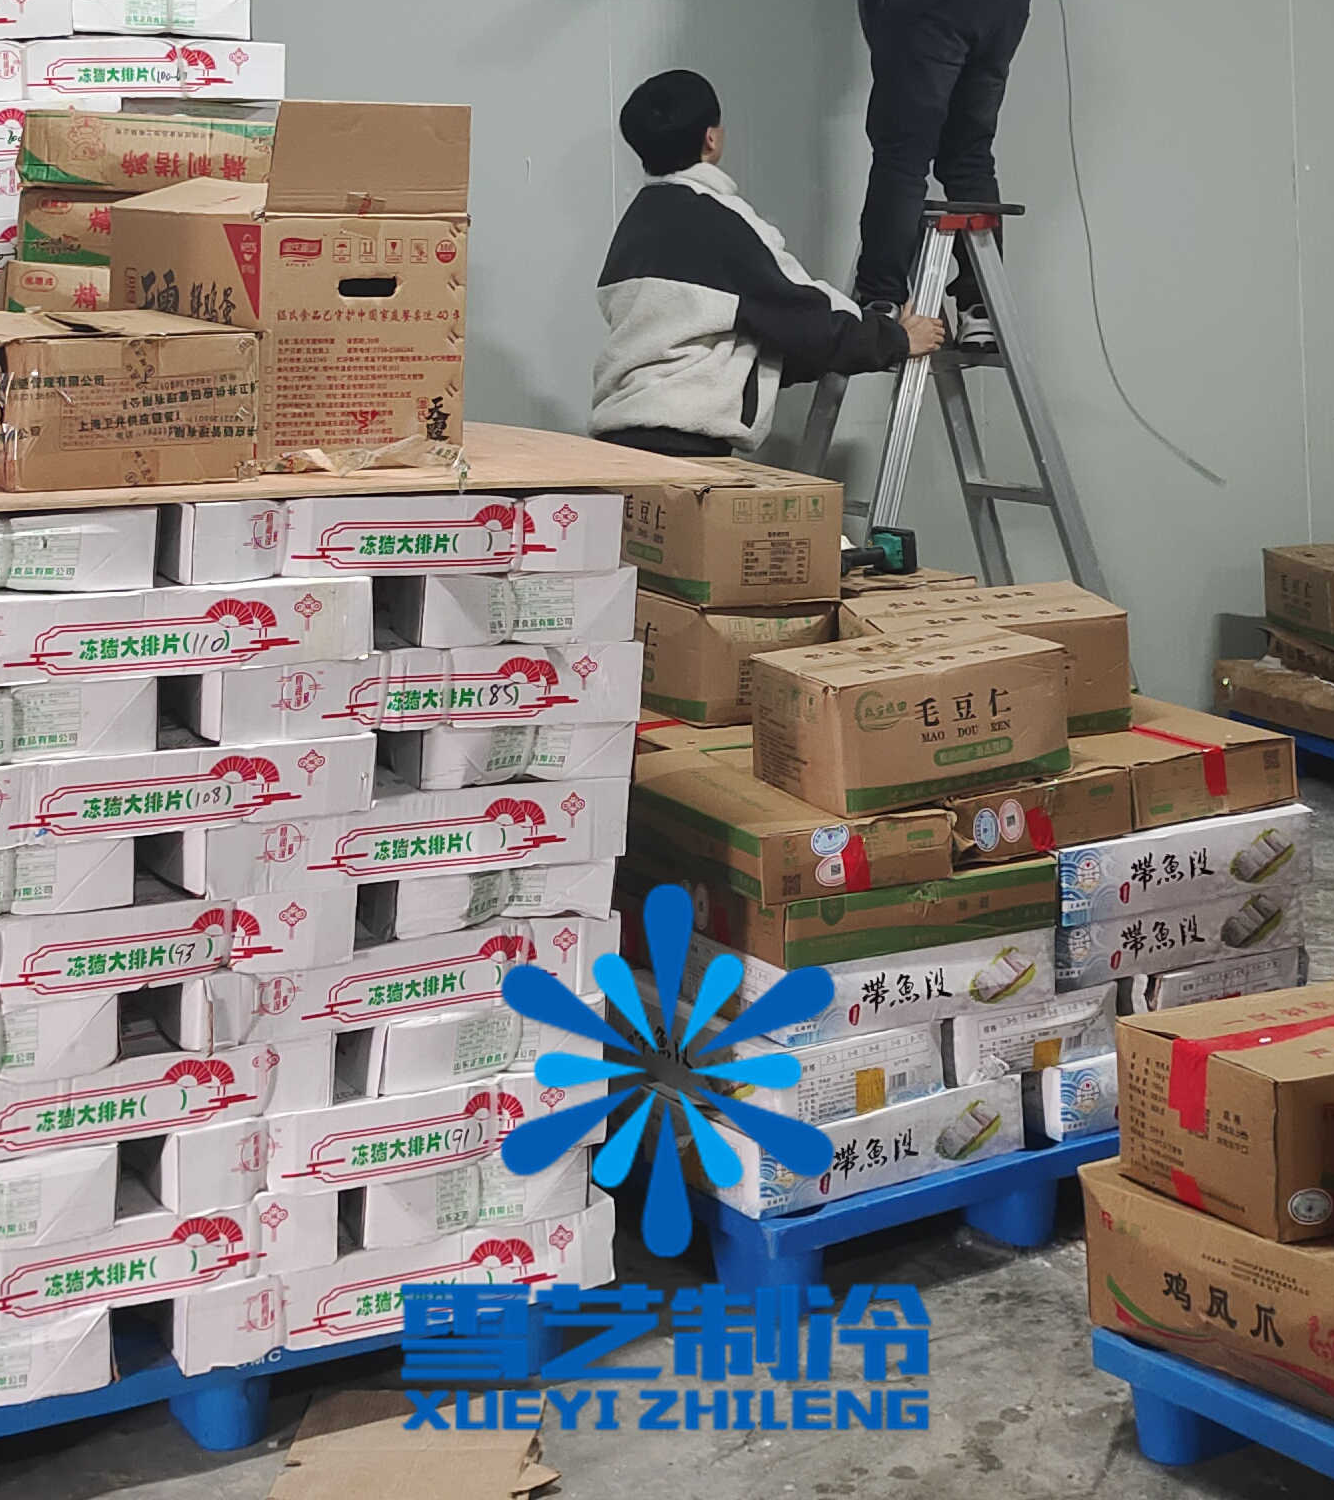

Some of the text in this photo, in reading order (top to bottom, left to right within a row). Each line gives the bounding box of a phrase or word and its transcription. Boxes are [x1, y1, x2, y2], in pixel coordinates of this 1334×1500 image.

[914, 687, 1012, 727] 毛豆仁
[921, 730, 946, 743] MAO
[957, 724, 979, 738] DOU
[1163, 1271, 1285, 1348] 鸡凤爪
